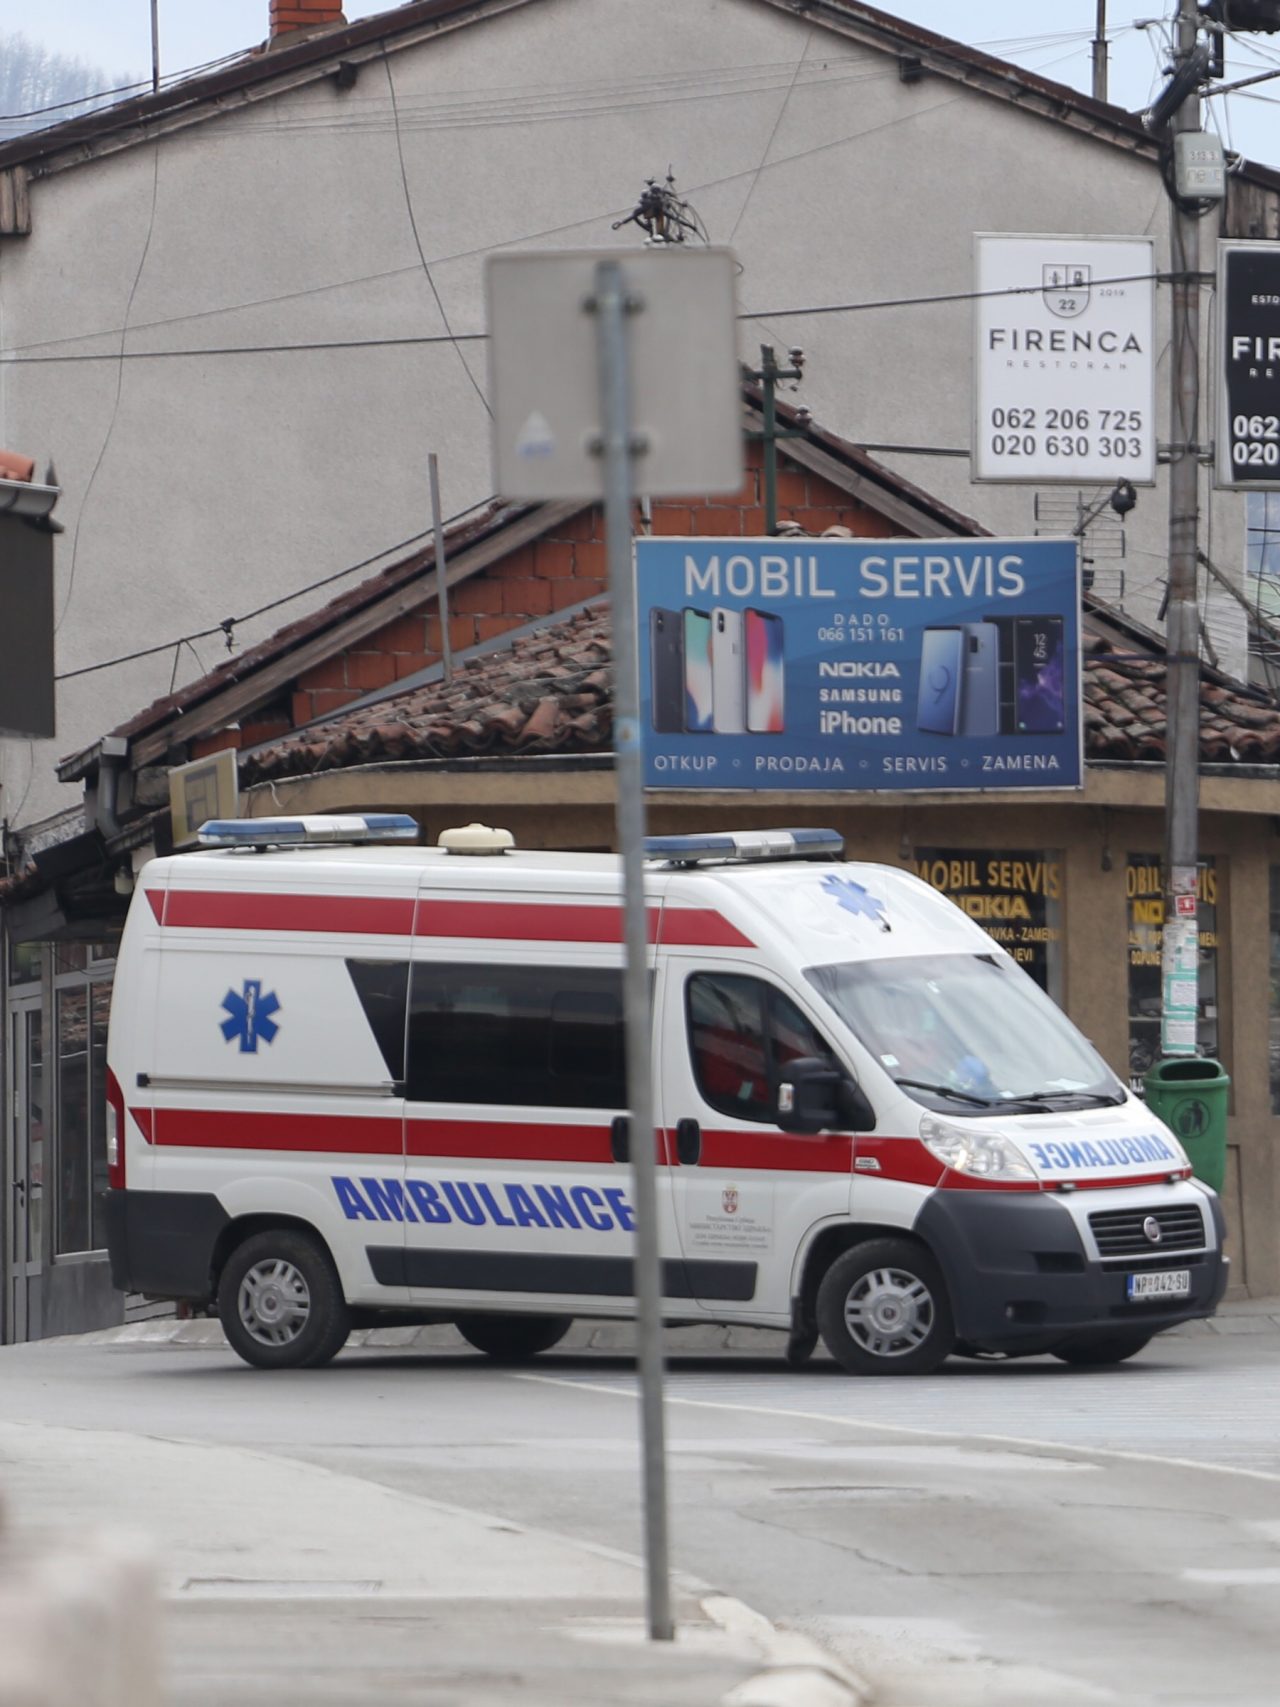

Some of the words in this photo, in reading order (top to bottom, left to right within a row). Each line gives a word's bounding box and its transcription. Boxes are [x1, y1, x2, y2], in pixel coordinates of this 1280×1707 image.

[1100, 288, 1125, 297] 2019
[1252, 295, 1280, 304] ESTD
[1058, 299, 1076, 311] 22
[989, 328, 1143, 354] FIRENCA
[1007, 360, 1127, 370] RESTORAN
[991, 408, 1036, 429] 062
[1045, 409, 1089, 430] 206
[1099, 410, 1142, 431] 725
[1233, 416, 1280, 440] 062
[991, 435, 1036, 456] 020
[1045, 436, 1089, 457] 630
[1099, 436, 1142, 458] 303
[1233, 441, 1280, 465] 020
[684, 555, 836, 598] MOBIL
[859, 555, 1025, 598] SERVIS
[834, 613, 889, 625] DADO
[818, 627, 845, 641] 066
[850, 628, 874, 641] 151
[880, 628, 904, 641] 161
[819, 661, 901, 677] NOKIA
[820, 688, 902, 702] SAMSUNG
[820, 710, 902, 734] iPhone
[654, 755, 717, 771] OTKUP
[755, 756, 845, 772] PRODAJA
[882, 756, 948, 772] SERVIS
[982, 754, 1060, 771] ZAMENA
[987, 860, 1061, 898] SERVIS
[331, 1176, 636, 1231] AMBULANCE
